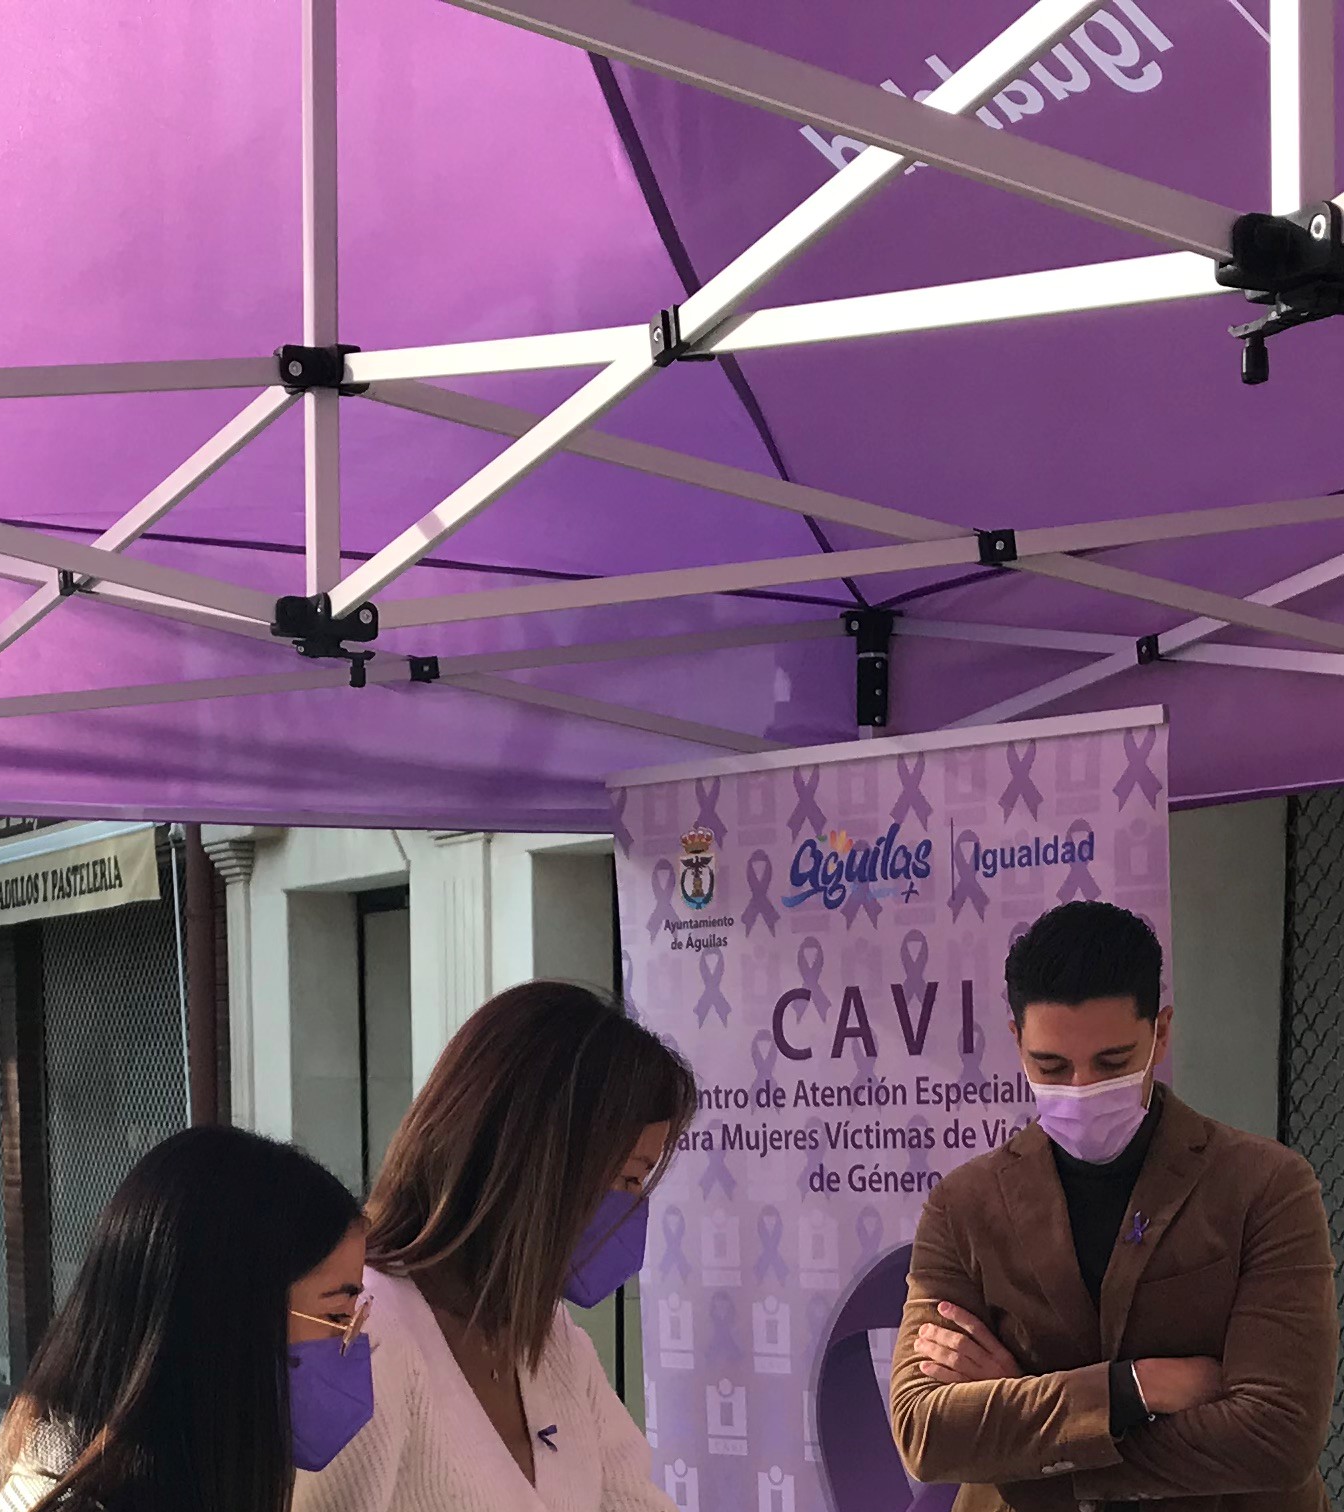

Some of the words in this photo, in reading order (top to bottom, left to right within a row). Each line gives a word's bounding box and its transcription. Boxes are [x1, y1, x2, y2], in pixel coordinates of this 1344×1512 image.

[973, 833, 1095, 878] Igualdad
[41, 870, 49, 902] Y
[51, 855, 123, 900] PASTELERIA
[664, 916, 734, 932] Ayuntamiento
[671, 938, 683, 950] de
[685, 933, 728, 952] Águilas
[772, 980, 975, 1060] CAVI
[697, 1085, 749, 1109] ntro
[756, 1080, 786, 1108] de
[793, 1076, 906, 1108] Atención
[915, 1072, 1036, 1112] Especiali
[678, 1130, 713, 1151] ara
[721, 1123, 819, 1158] Mujeres
[825, 1121, 935, 1150] Víctimas
[943, 1119, 976, 1149] de
[809, 1163, 840, 1192] de
[847, 1164, 942, 1193] Género
